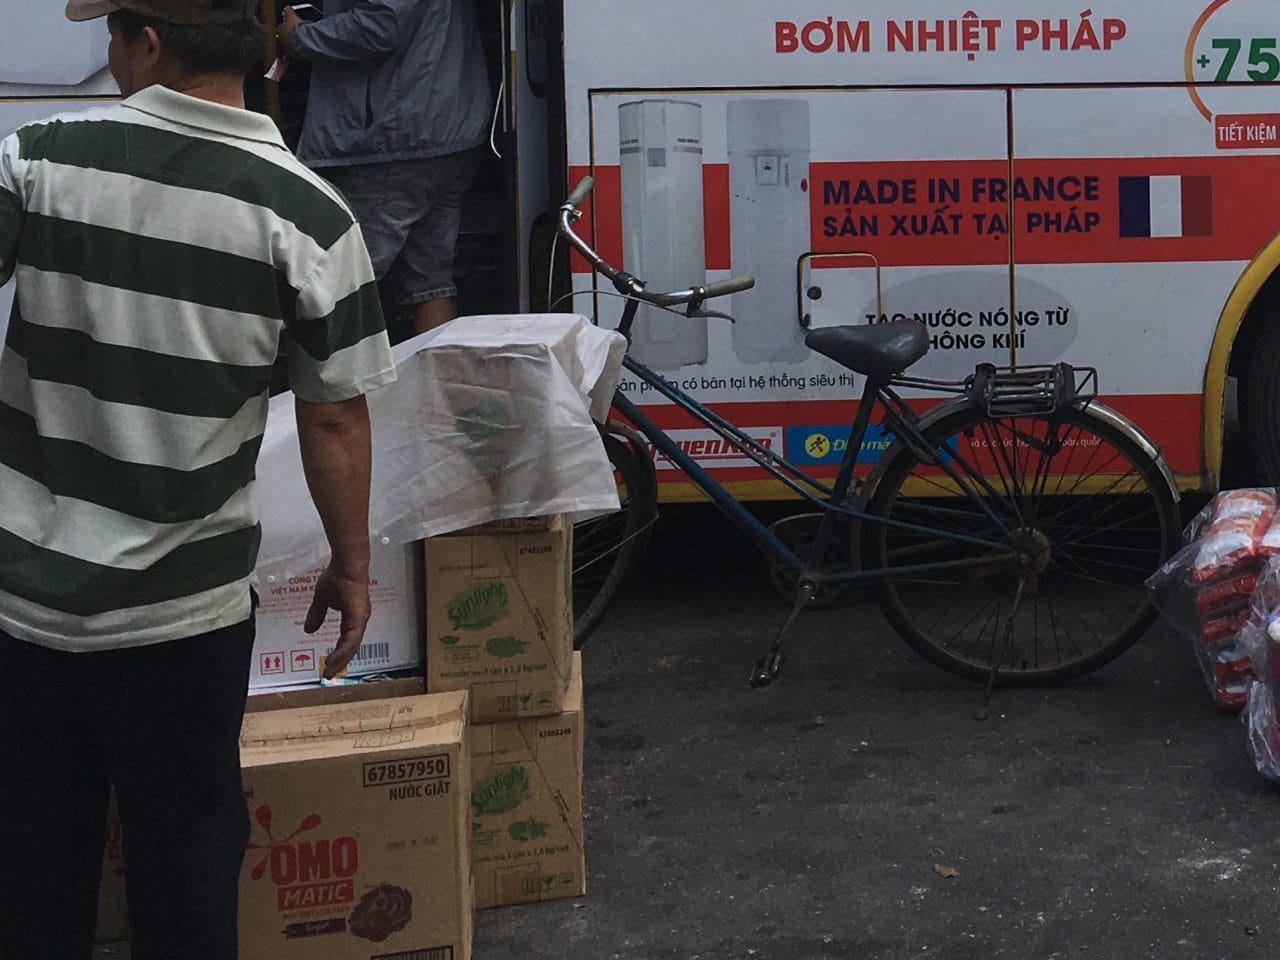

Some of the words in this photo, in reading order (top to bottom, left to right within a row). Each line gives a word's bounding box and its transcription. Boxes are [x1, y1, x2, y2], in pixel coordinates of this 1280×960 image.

[775, 16, 871, 54] BƠM
[887, 10, 1002, 61] NHIỆT
[1016, 8, 1127, 51] PHÁP
[1218, 121, 1244, 142] TIẾT
[1246, 123, 1276, 144] KIỆM
[823, 179, 916, 205] MADE
[928, 178, 960, 203] IN
[972, 176, 1099, 203] FRANCE
[823, 208, 879, 238] SẢN
[890, 204, 963, 236] XUẤT
[1027, 206, 1101, 234] PHÁP
[912, 307, 973, 328] NƯỚC
[974, 307, 1040, 328] NÓNG
[1045, 306, 1070, 327] TỪ
[928, 332, 985, 350] HÔNG
[682, 377, 698, 390] có
[701, 374, 727, 389] bán
[730, 374, 746, 391] tại
[750, 374, 767, 389] hệ
[768, 373, 806, 391] thống
[809, 374, 836, 387] siêu
[839, 374, 855, 388] thị
[449, 581, 507, 620] Sunlight
[368, 759, 445, 782] 67857950
[389, 784, 422, 801] NƯỚC
[425, 781, 450, 797] GIẶT
[270, 836, 359, 886] OMO
[284, 883, 348, 907] MATIC
